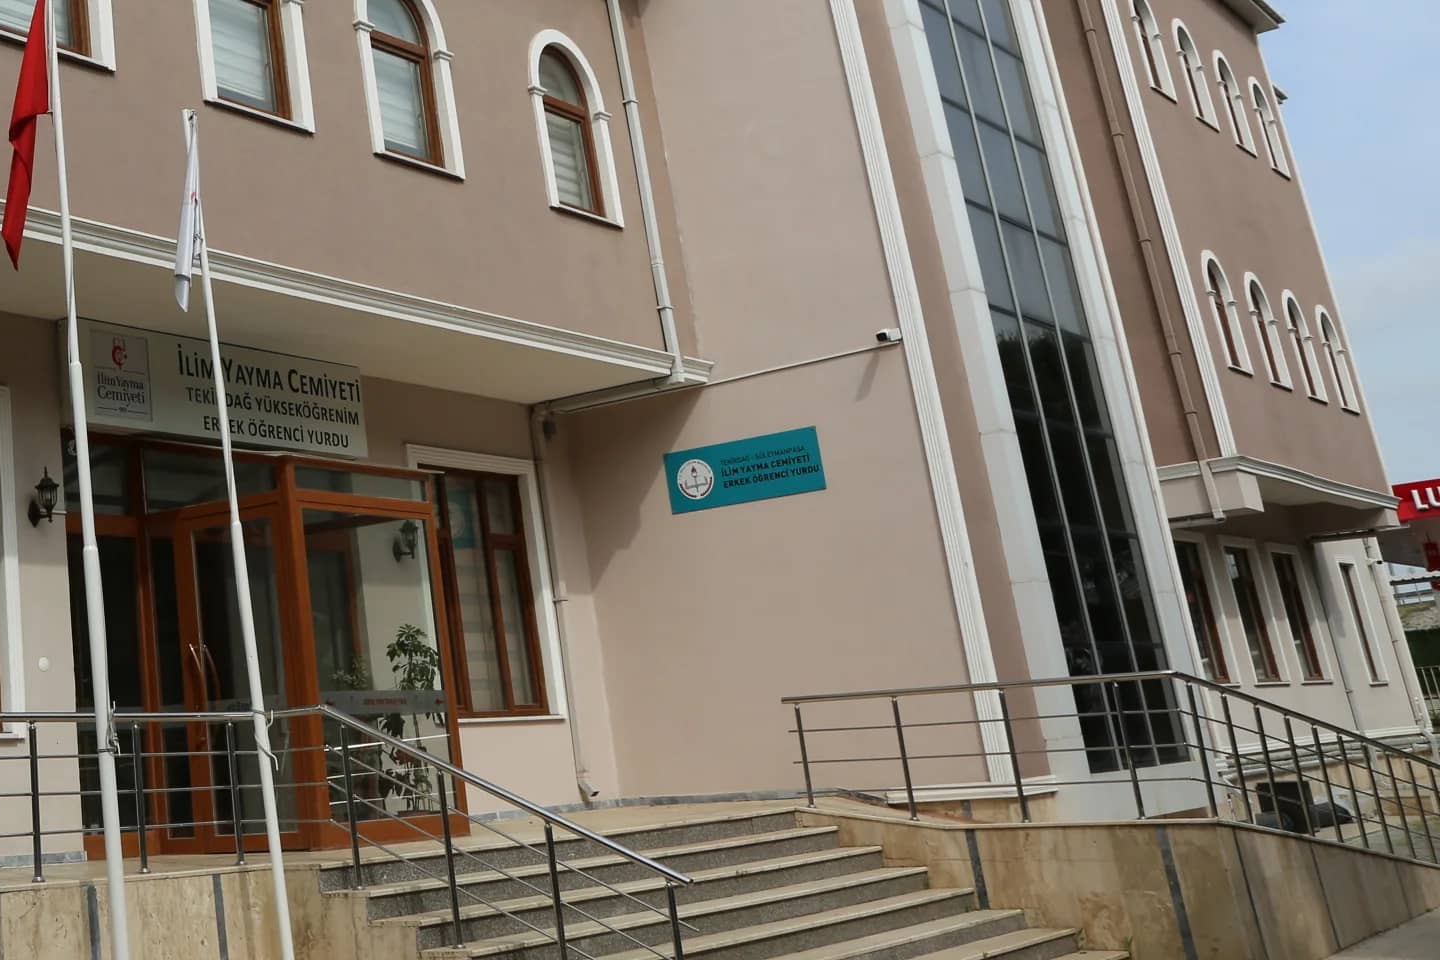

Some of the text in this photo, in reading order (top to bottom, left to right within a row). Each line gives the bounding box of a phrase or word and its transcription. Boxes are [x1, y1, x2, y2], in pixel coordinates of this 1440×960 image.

[220, 356, 284, 391] YAYMA
[287, 368, 361, 403] CEMİYETİ
[185, 386, 360, 426] TEKİDAĞ YÜKSEKÖĞRENİM
[203, 415, 349, 449] EREK ÖĞRENCİ YURDU
[790, 464, 820, 476] YURDU
